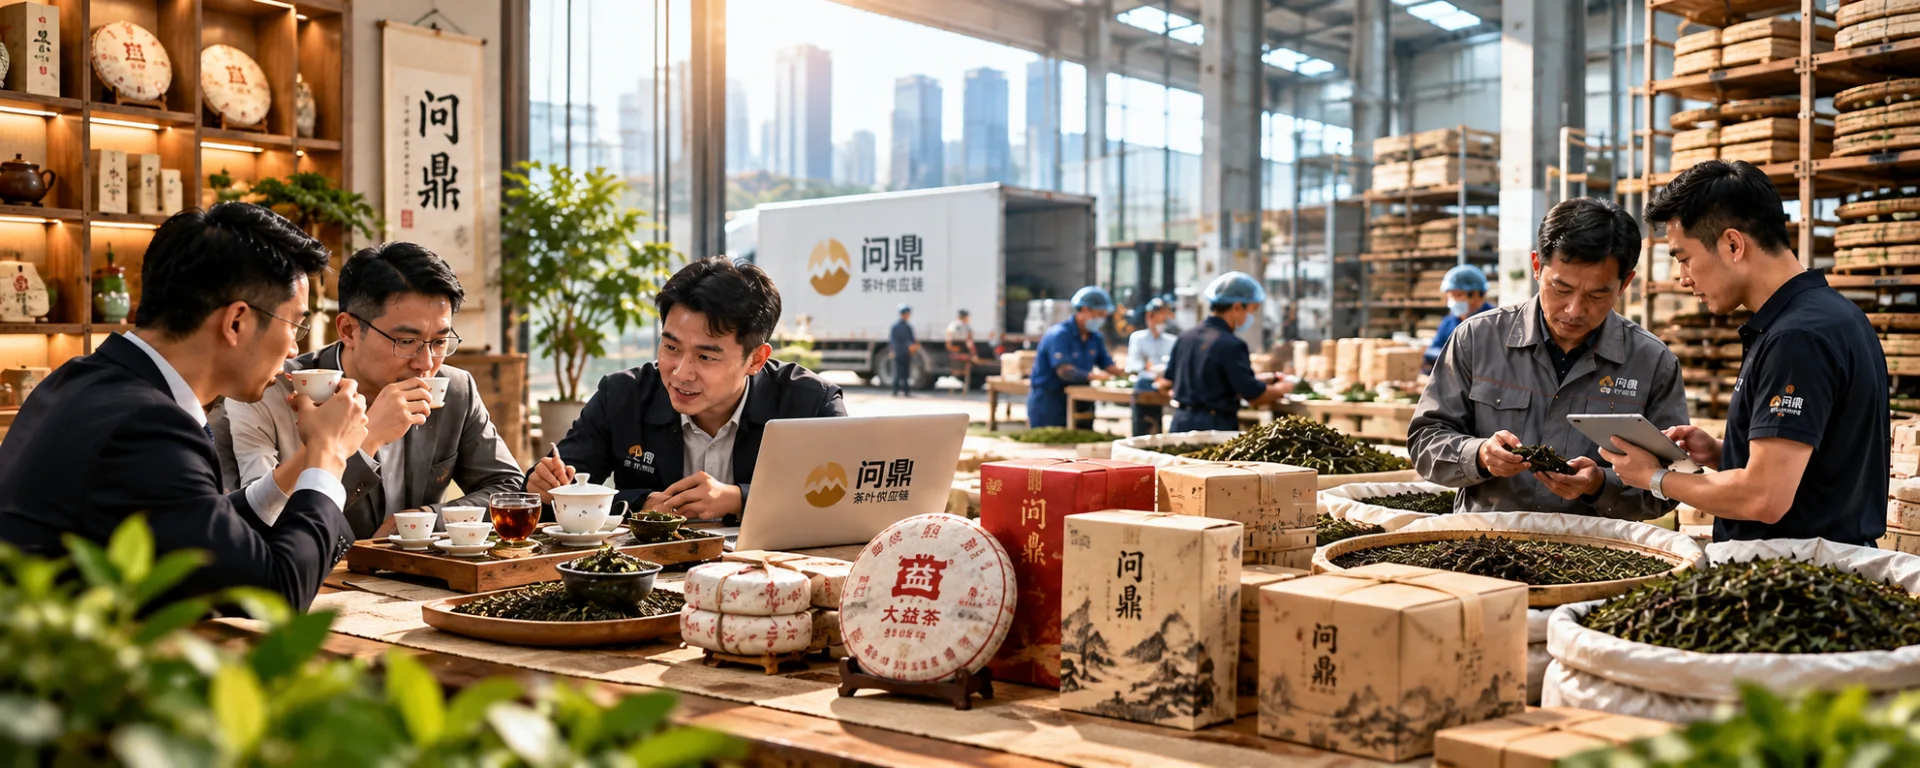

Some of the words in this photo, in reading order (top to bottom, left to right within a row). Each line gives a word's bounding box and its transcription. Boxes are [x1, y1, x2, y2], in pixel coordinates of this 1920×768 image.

[418, 89, 461, 211] 问鼎
[862, 234, 923, 273] 问鼎
[862, 276, 924, 293] 茶叶供应链
[856, 459, 914, 489] 问鼎
[1021, 498, 1047, 566] 问鼎
[1115, 550, 1145, 620] 问鼎
[881, 605, 942, 627] 大益茶
[1312, 622, 1338, 687] 问鼎
